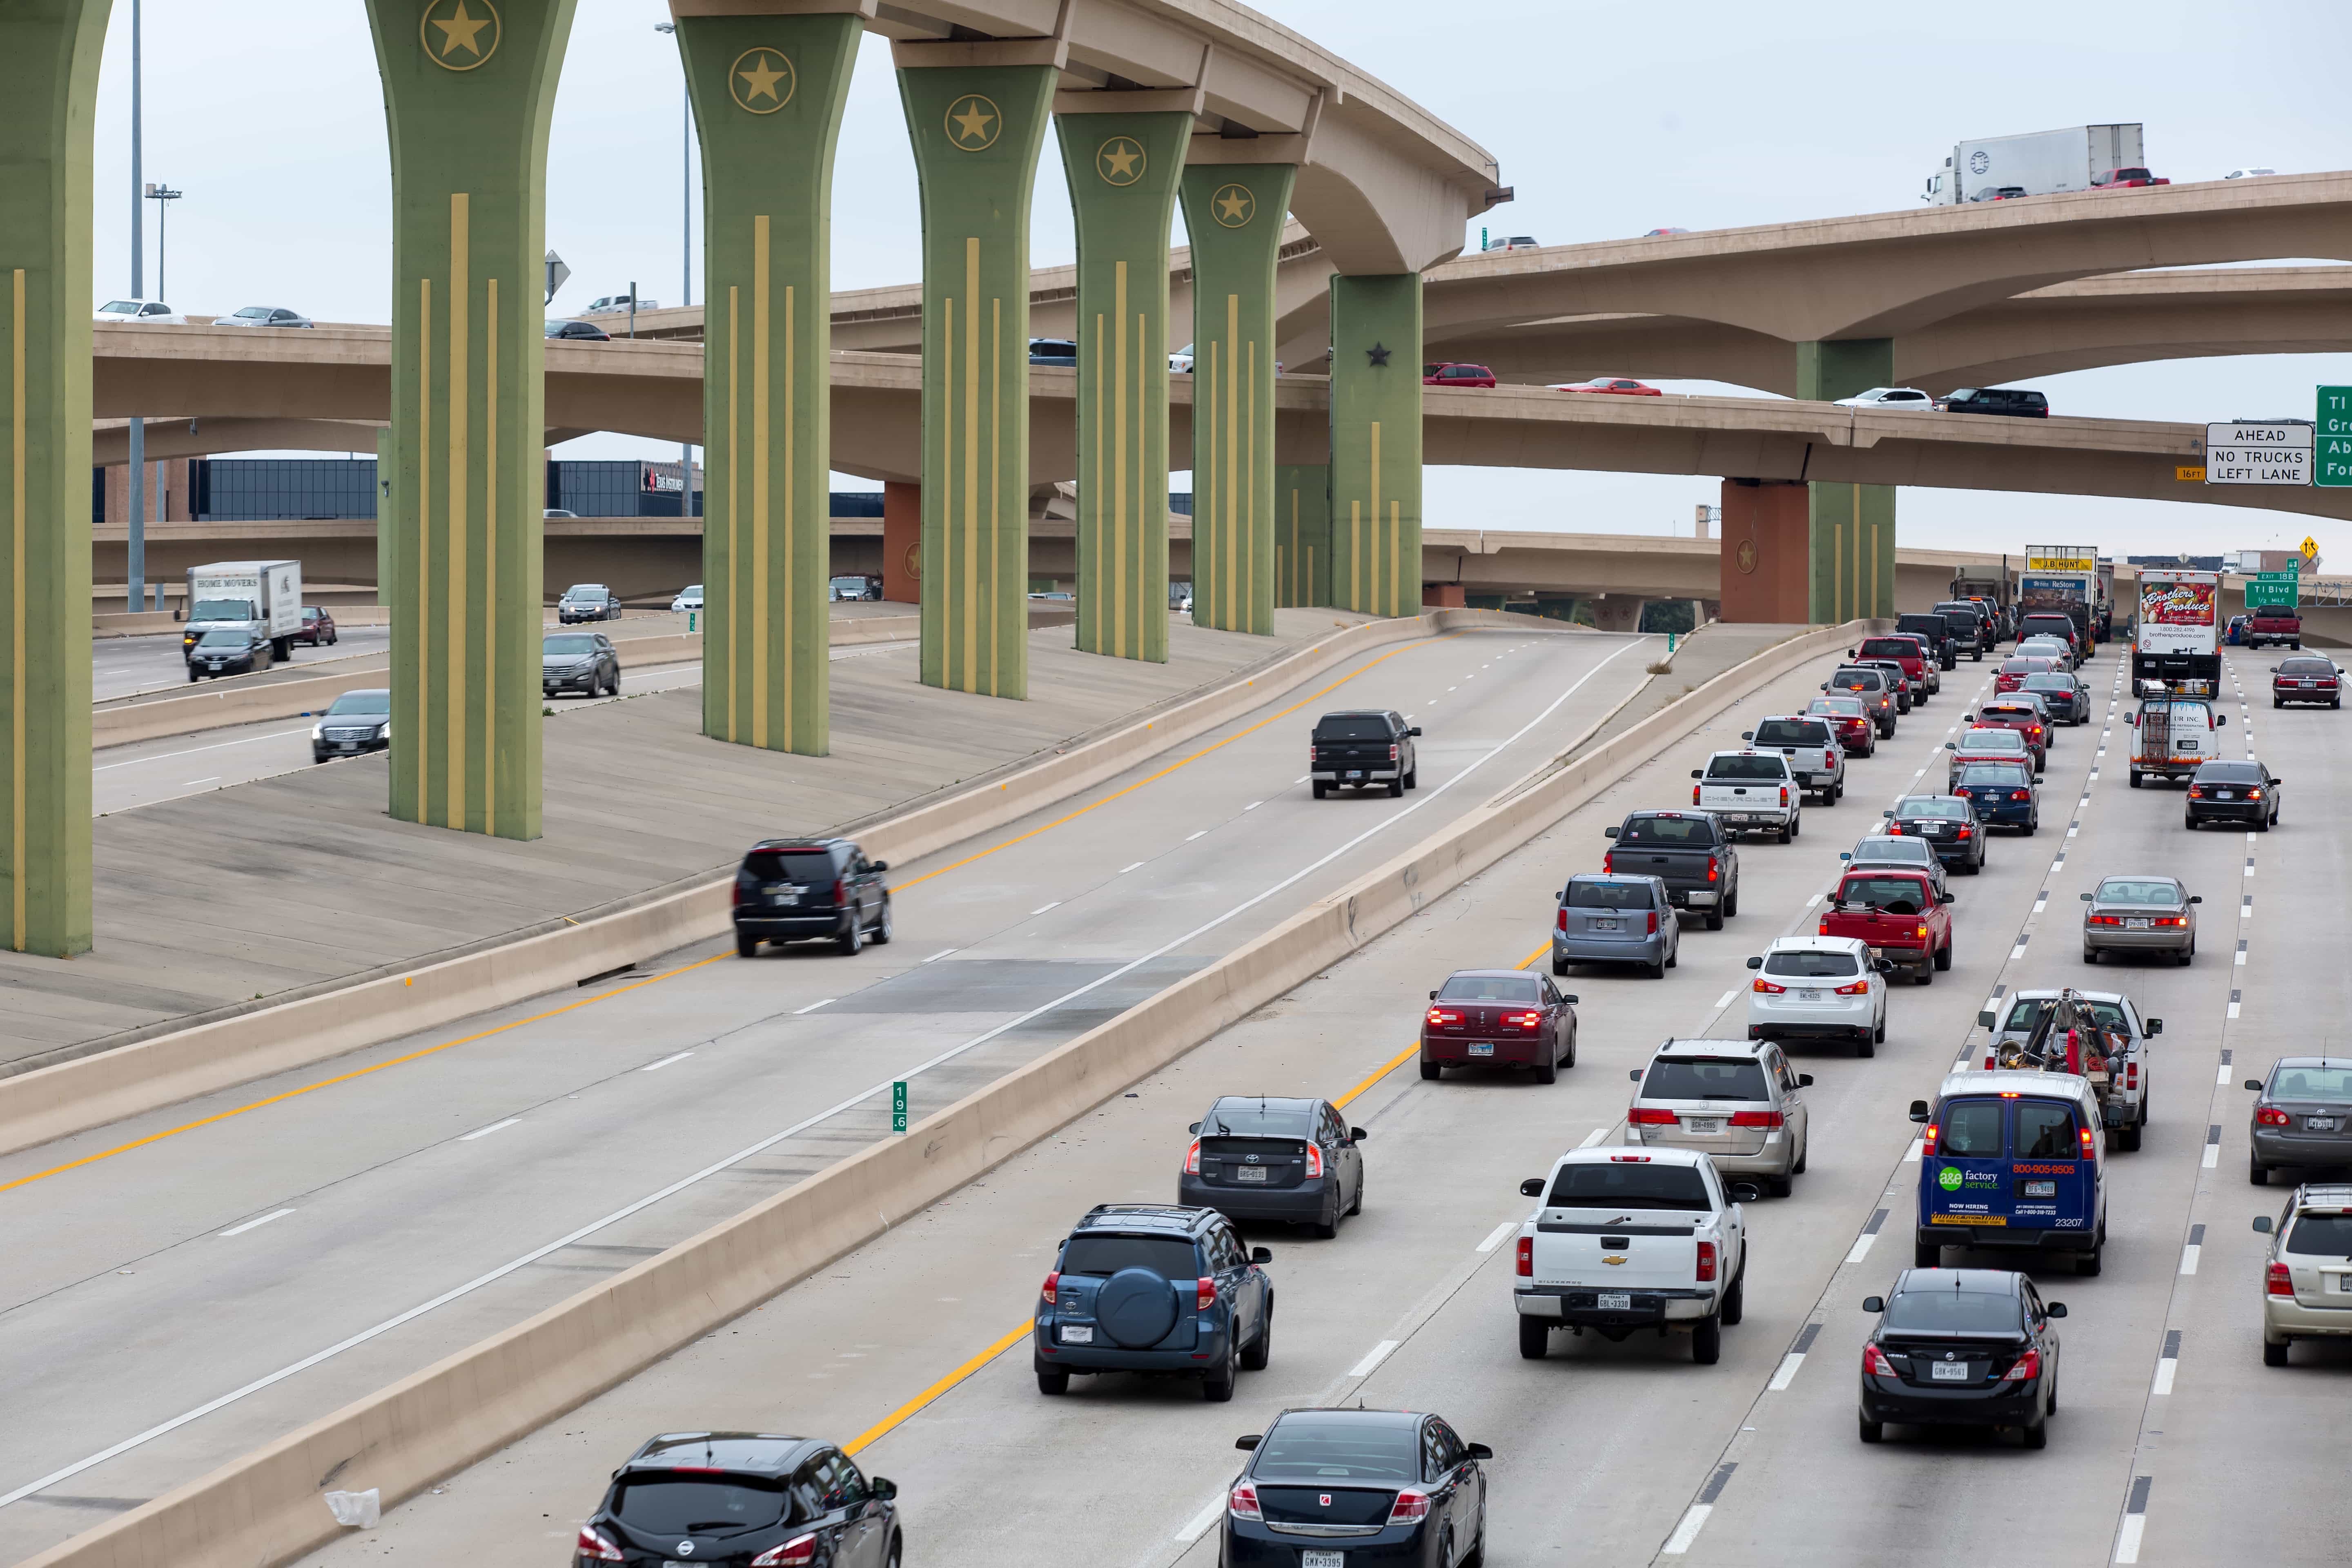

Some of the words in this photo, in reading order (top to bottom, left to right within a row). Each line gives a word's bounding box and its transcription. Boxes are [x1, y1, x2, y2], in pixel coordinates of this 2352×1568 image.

[2329, 396, 2345, 409] TI
[2328, 419, 2352, 431] Gr
[2235, 430, 2285, 441] AHEAD
[2216, 451, 2235, 462] NO
[2245, 452, 2303, 463] TRUCKS
[2218, 468, 2252, 479] LEFT
[2262, 469, 2300, 480] LANE
[666, 474, 683, 491] INSTRUMEN
[197, 579, 223, 588] HOME
[224, 579, 258, 587] MOVERS
[2146, 588, 2195, 605] Brothers
[2163, 601, 2210, 615] Produce
[2013, 1165, 2075, 1174] 800-905-9505
[1940, 1173, 1962, 1185] a&e
[1965, 1170, 1998, 1183] factory
[1965, 1180, 1998, 1189] service
[2055, 1218, 2082, 1227] 23207
